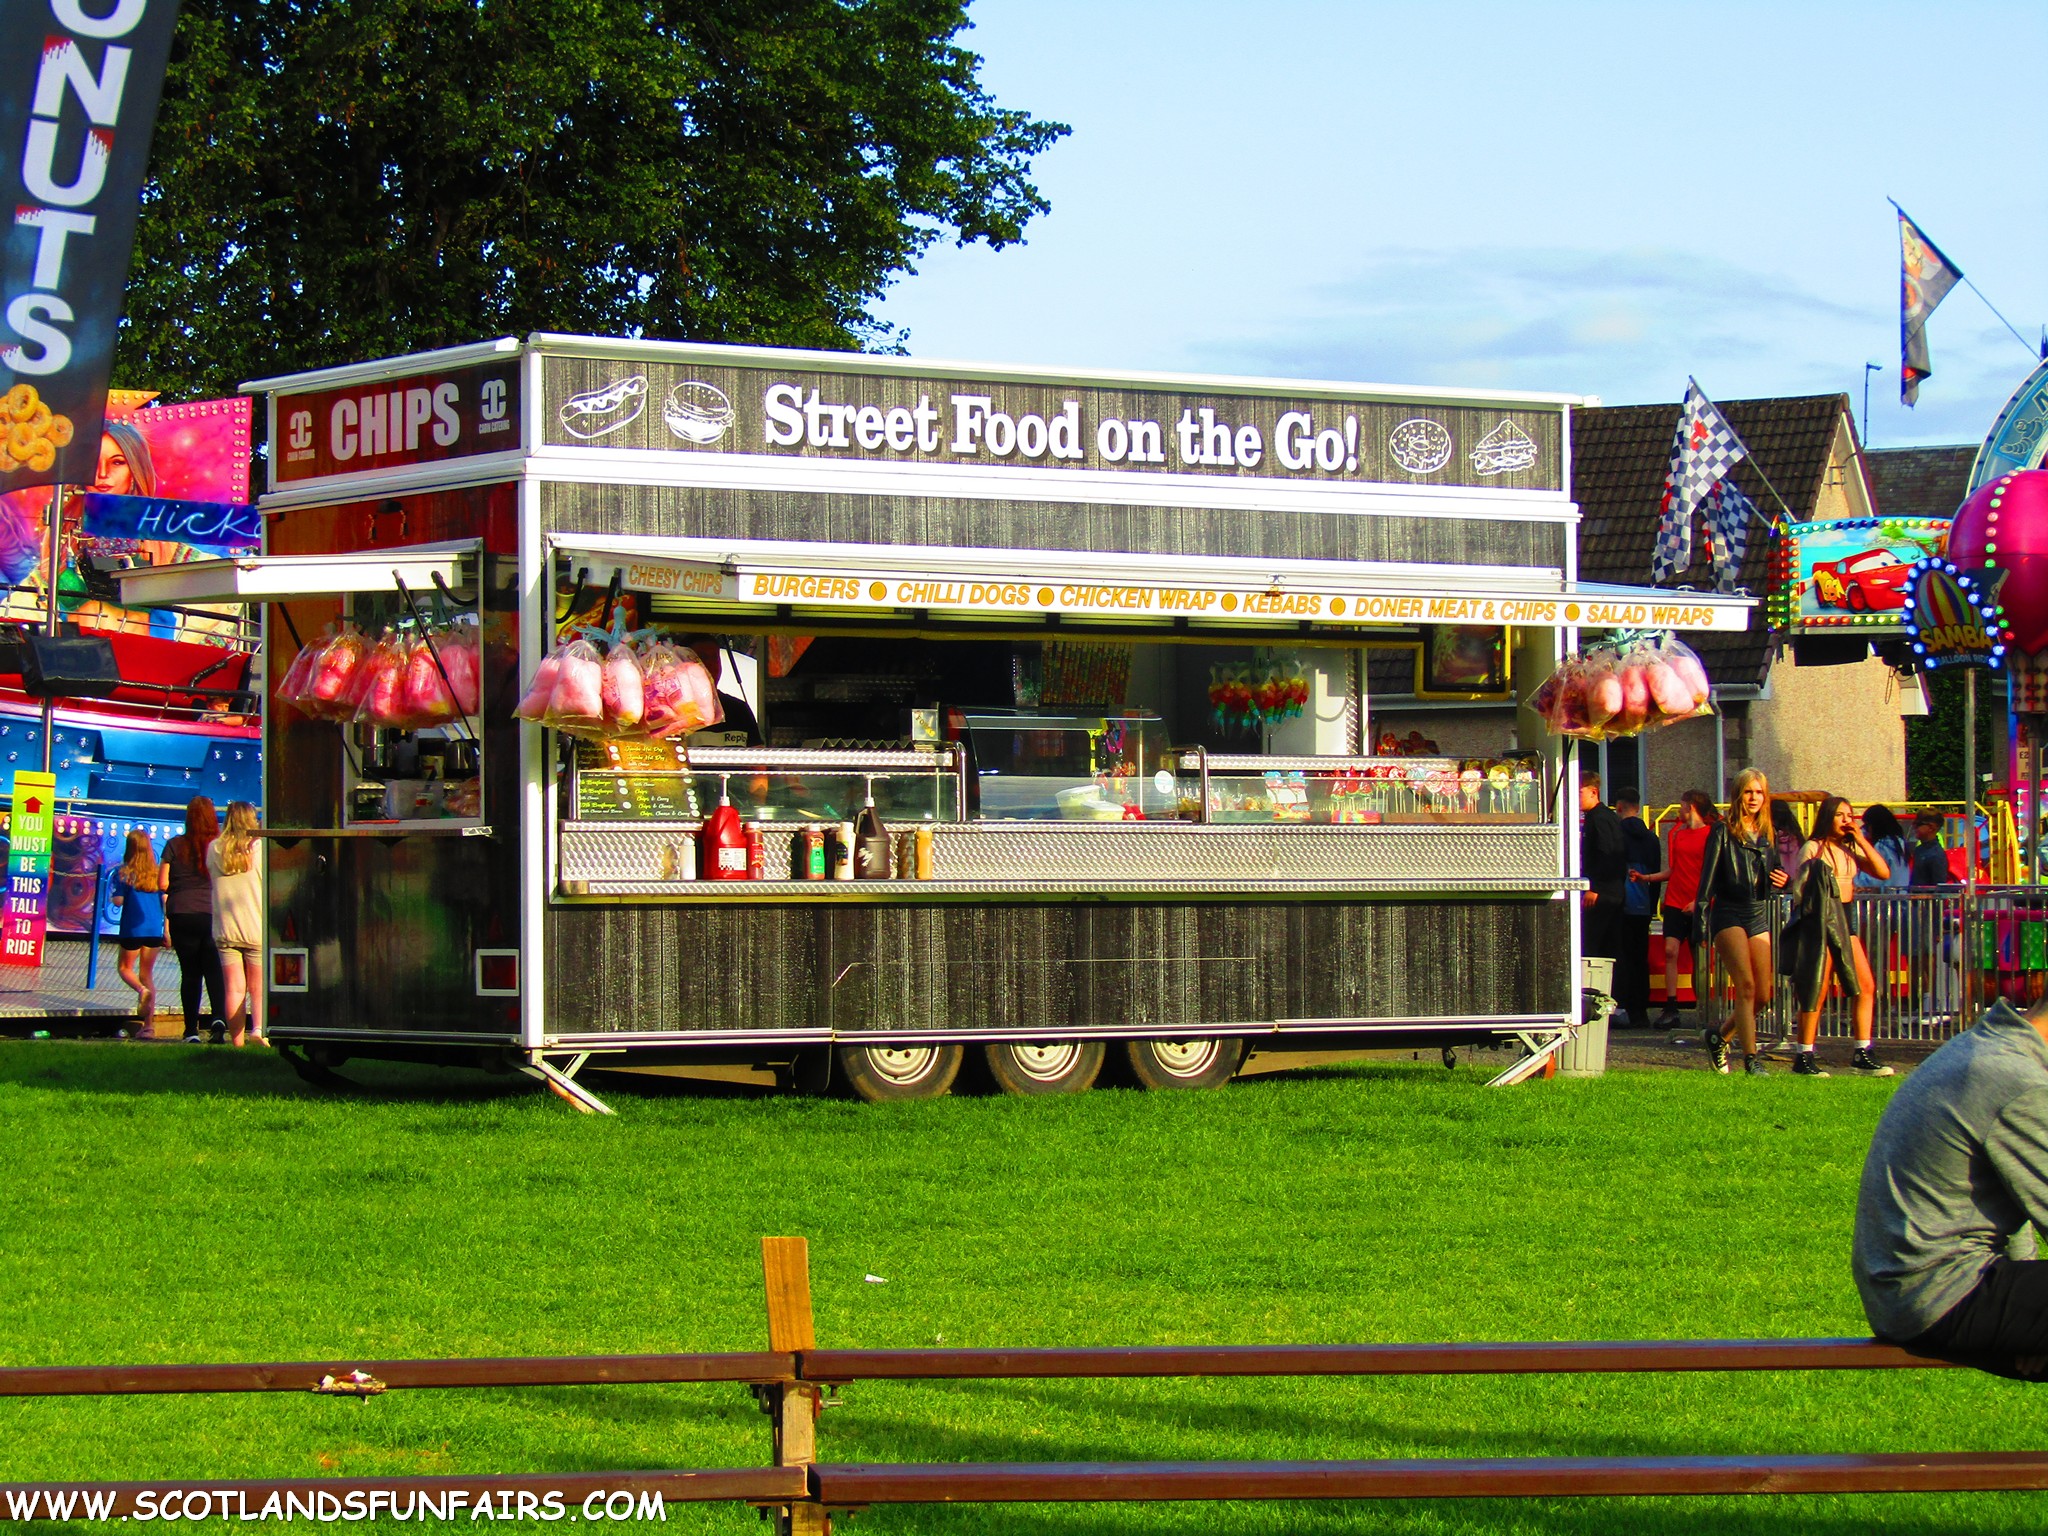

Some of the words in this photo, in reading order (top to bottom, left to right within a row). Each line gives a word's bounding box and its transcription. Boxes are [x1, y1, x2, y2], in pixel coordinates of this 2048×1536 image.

[331, 382, 460, 461] CHIPS
[764, 382, 939, 452] Street
[950, 393, 1084, 460] Food
[1097, 418, 1166, 464] on
[1176, 407, 1263, 468] the
[1274, 410, 1360, 473] Go!
[628, 564, 681, 590] CHEESY
[683, 569, 724, 595] CHIPS
[753, 574, 860, 600] BURGERS
[896, 581, 967, 604] CHILLI
[969, 583, 1031, 606] DOGS
[1060, 584, 1154, 609] CHICKEN
[1158, 588, 1217, 611] WRAP
[1243, 593, 1322, 615] KEBABS
[1354, 597, 1423, 619] DONER
[1427, 599, 1480, 620] MEAT
[1482, 600, 1495, 620] &
[1500, 601, 1557, 622] CHIPS
[1586, 603, 1647, 624] SALAD
[1651, 606, 1715, 627] WRAPS
[1919, 624, 1994, 653] SAMBA
[18, 815, 43, 832] YOU
[12, 835, 47, 853] MUST
[20, 856, 36, 873] BE
[12, 876, 41, 894] THIS
[10, 896, 39, 915] TALL
[15, 918, 31, 935] TO
[6, 938, 35, 956] RIDE
